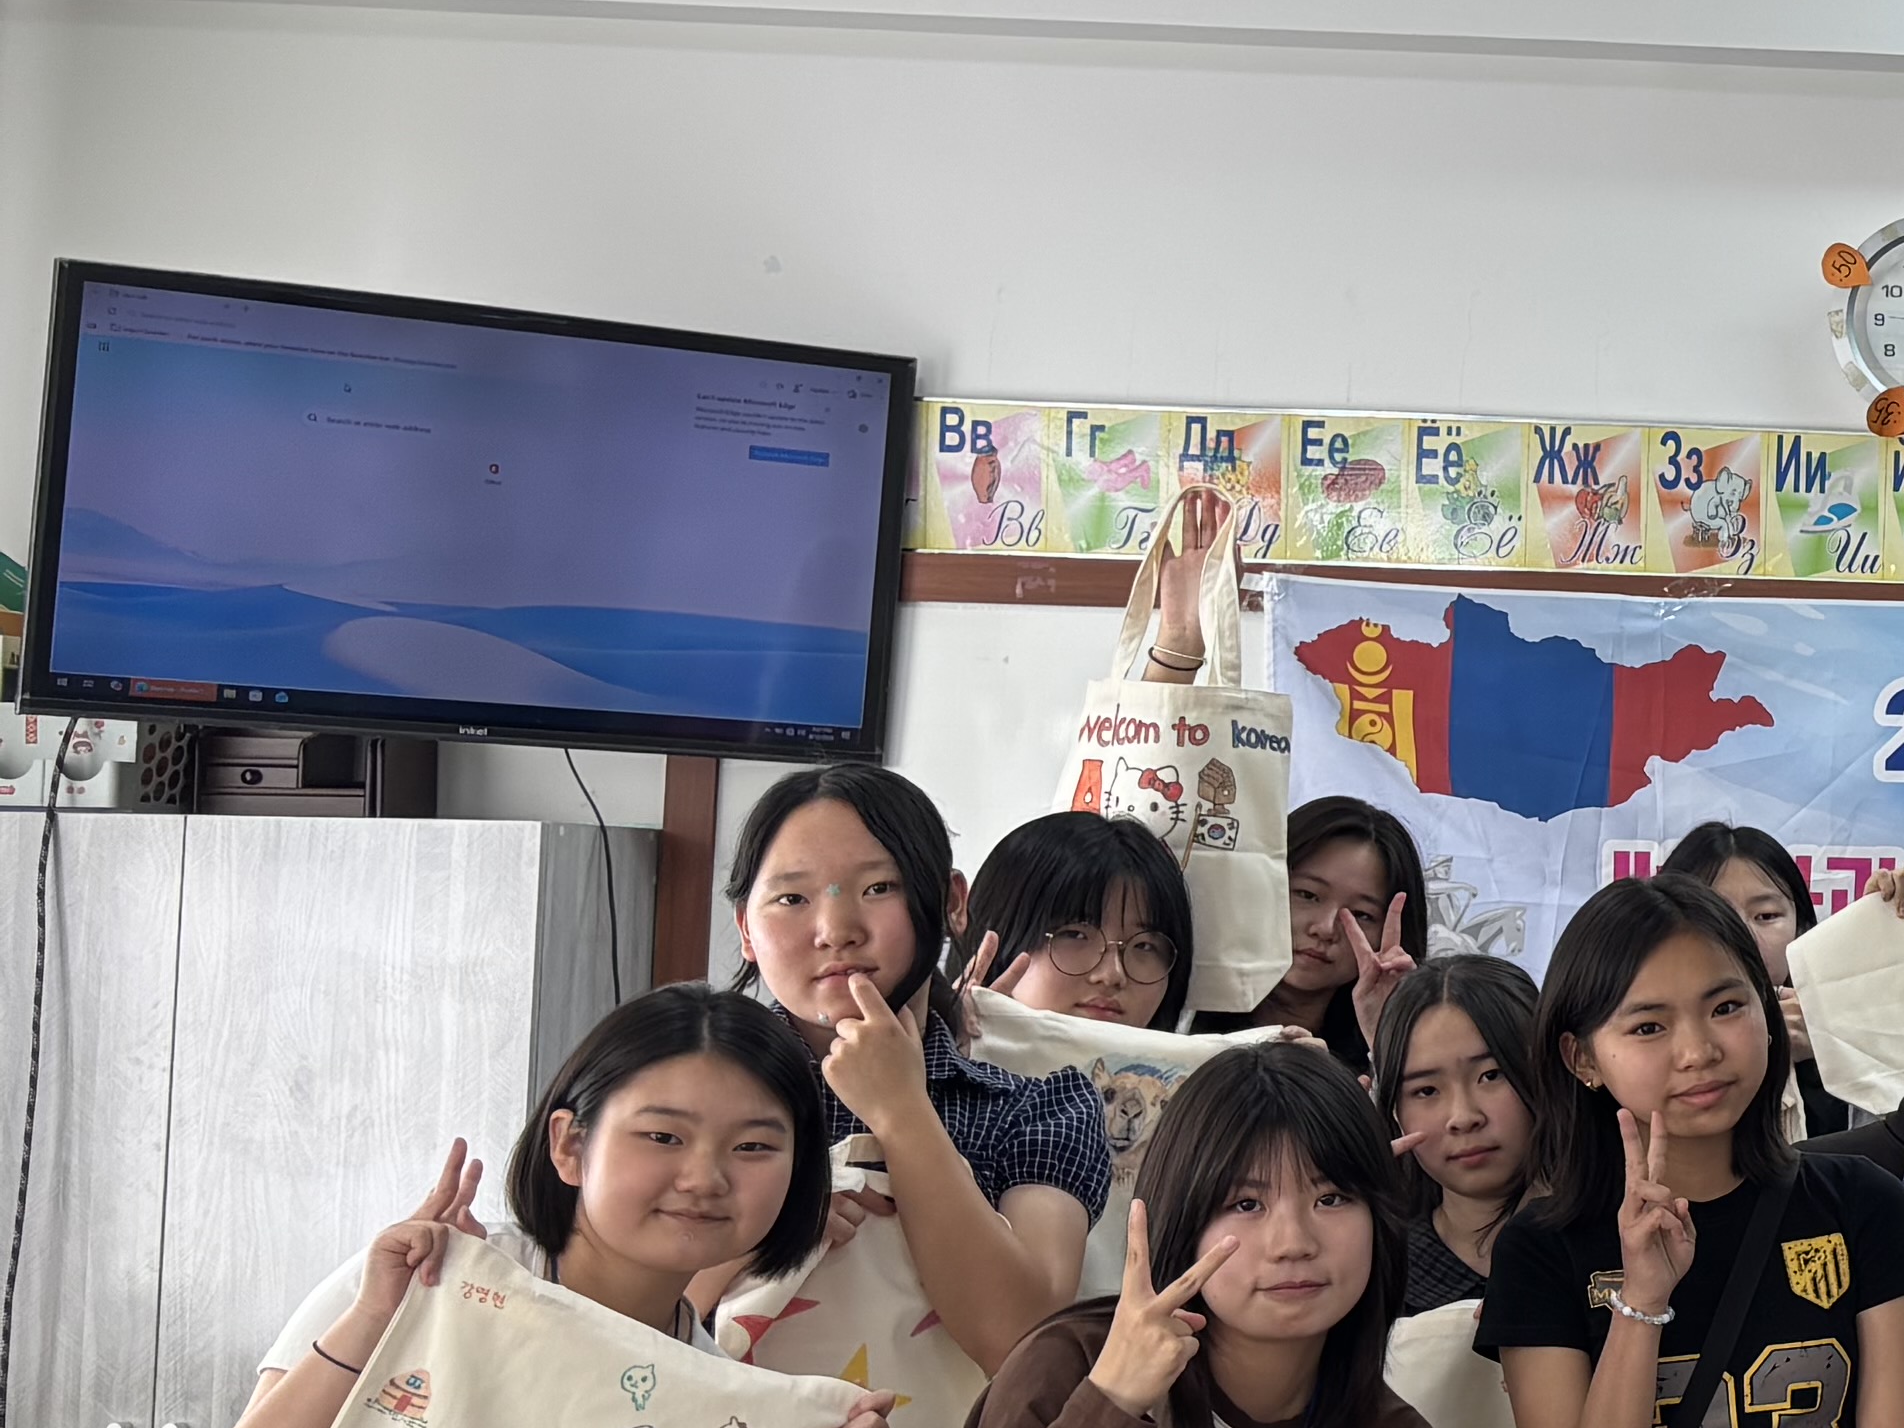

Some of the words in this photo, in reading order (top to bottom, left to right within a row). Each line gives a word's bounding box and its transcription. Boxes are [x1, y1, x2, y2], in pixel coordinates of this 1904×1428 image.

[1881, 285, 1903, 298] 10
[1874, 313, 1885, 327] 9
[1884, 344, 1896, 357] 8
[938, 406, 993, 455] Вв
[1065, 411, 1105, 458] Гг
[1300, 420, 1349, 467] Ее
[1417, 419, 1464, 484] Ёё
[1533, 425, 1600, 487] Жж
[1658, 431, 1704, 491] Зз
[1776, 435, 1829, 493] Ии
[1172, 716, 1210, 747] to
